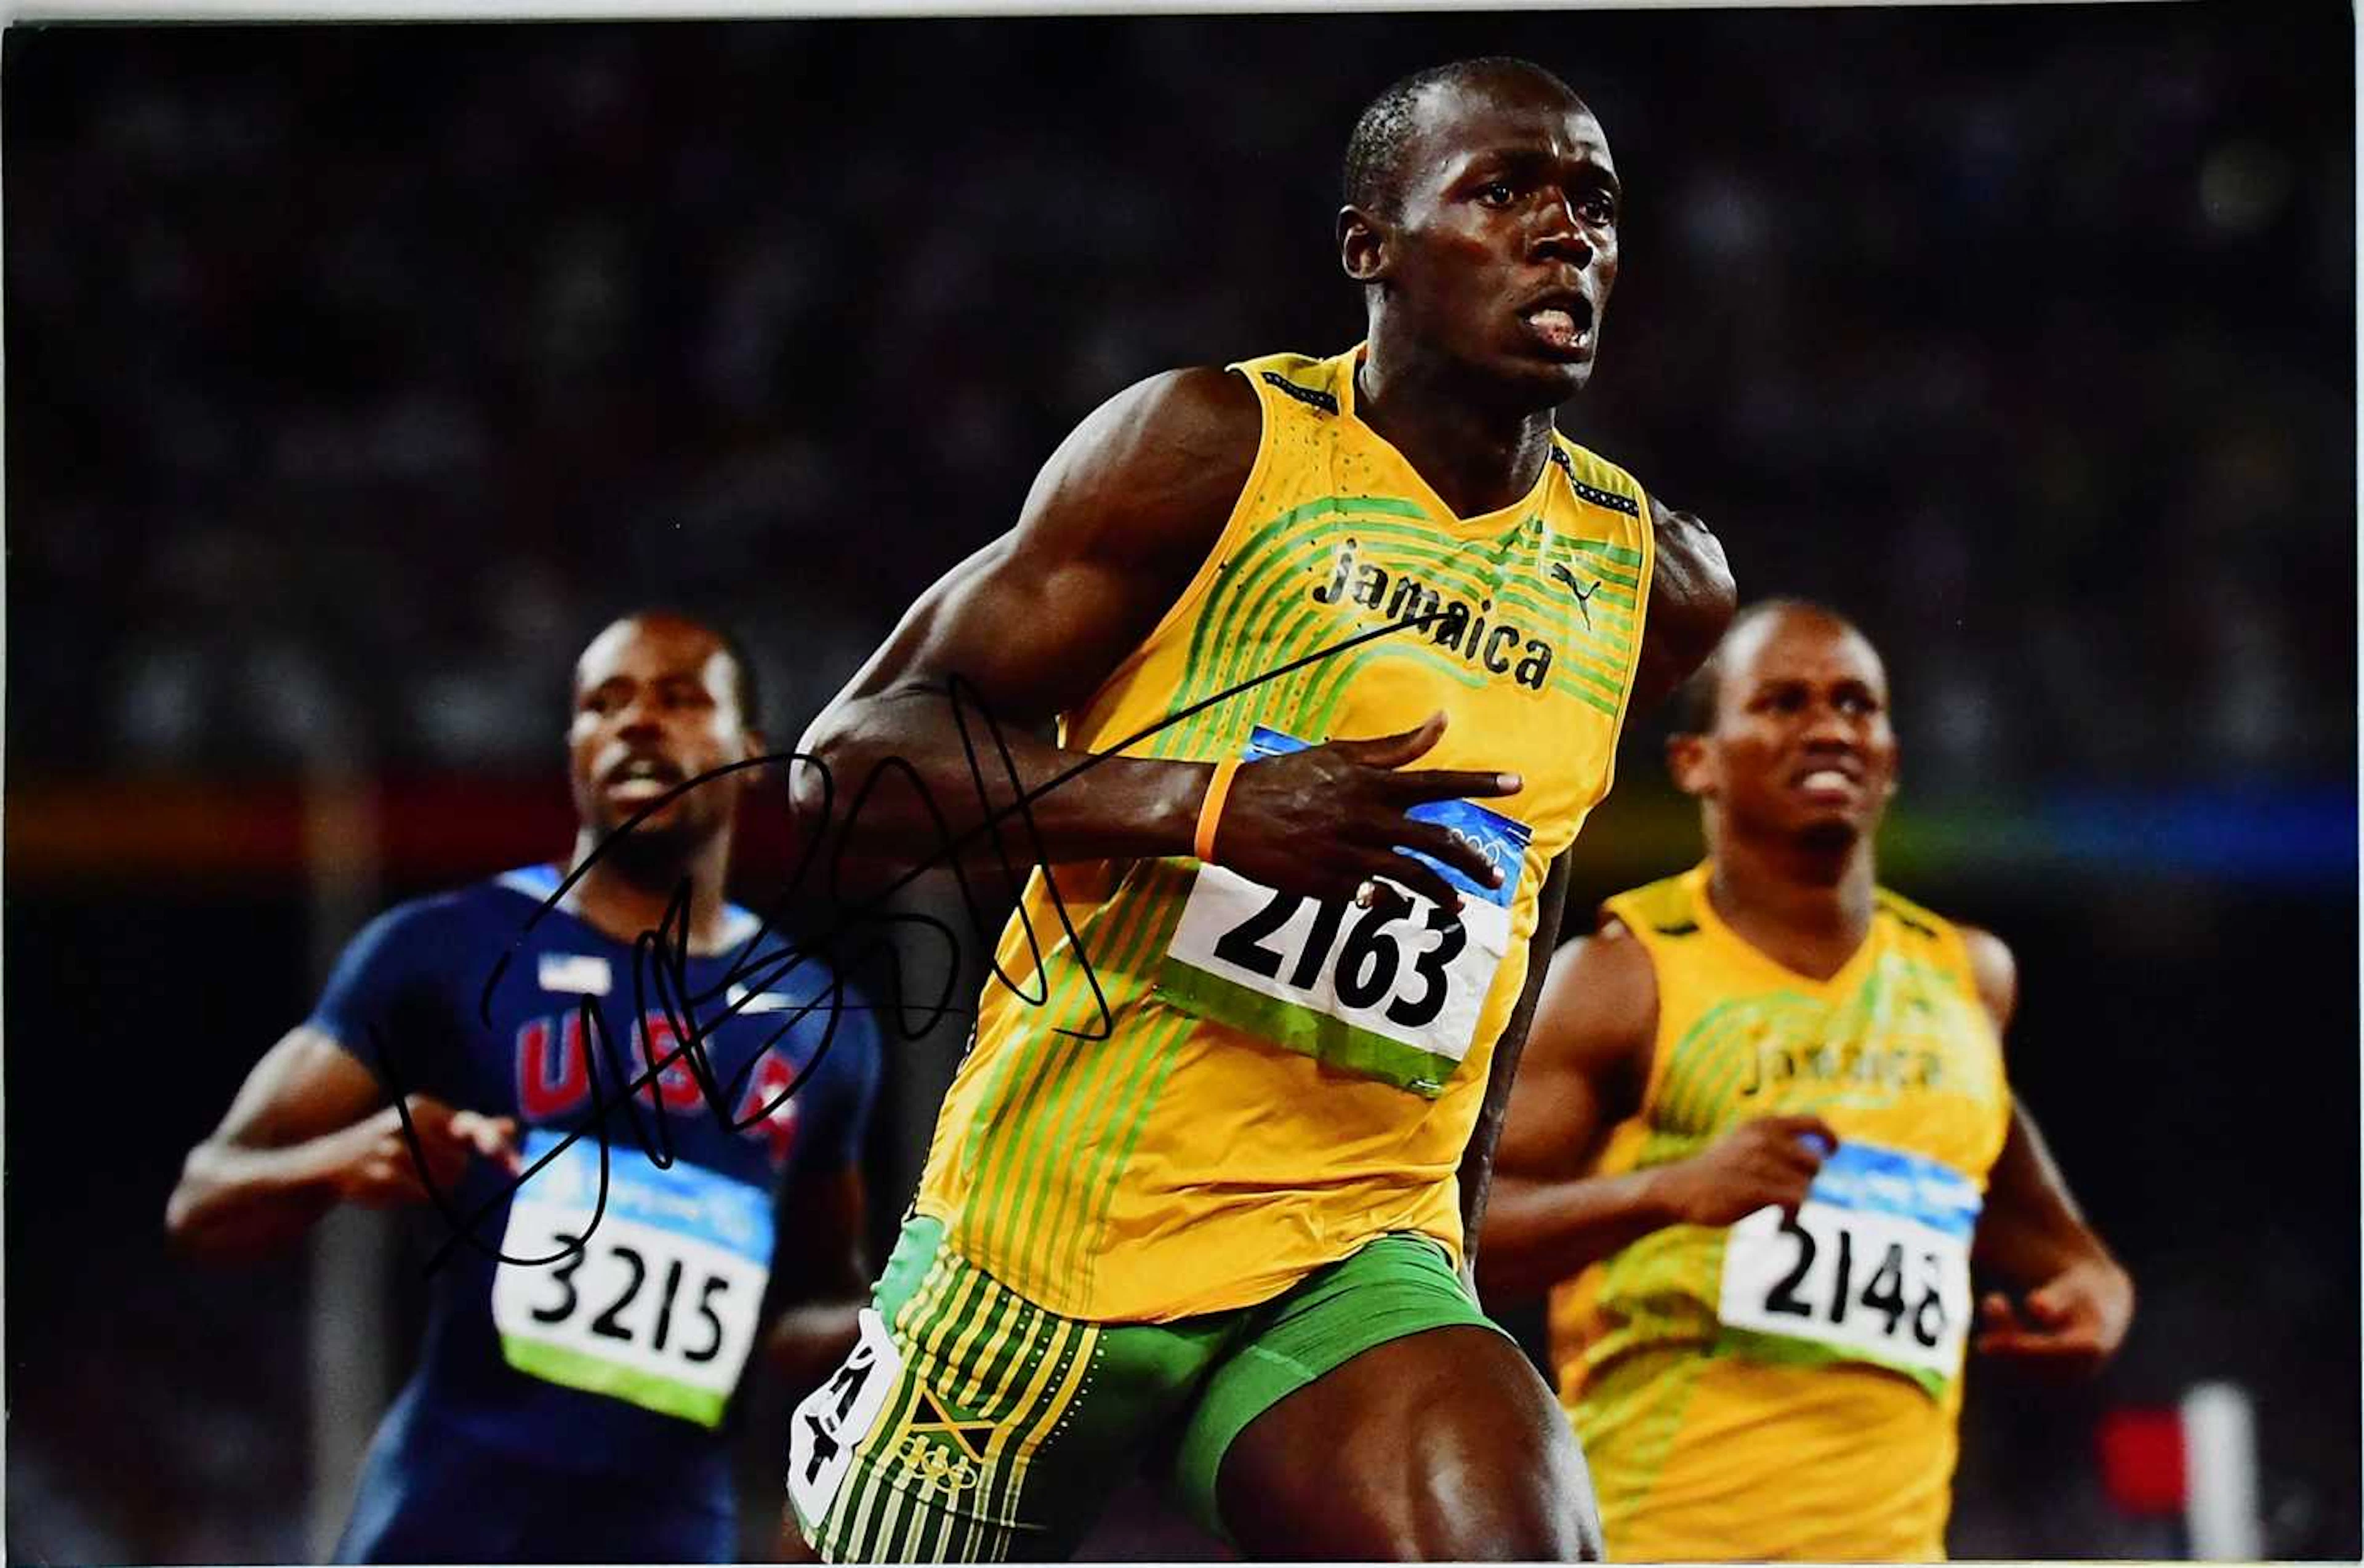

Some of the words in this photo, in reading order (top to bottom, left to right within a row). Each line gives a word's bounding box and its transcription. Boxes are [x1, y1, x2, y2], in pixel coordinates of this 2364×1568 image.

[1313, 537, 1553, 691] jamaica
[1213, 894, 1468, 1027] 2163
[516, 1008, 802, 1162] USA
[531, 1232, 730, 1363] 3215
